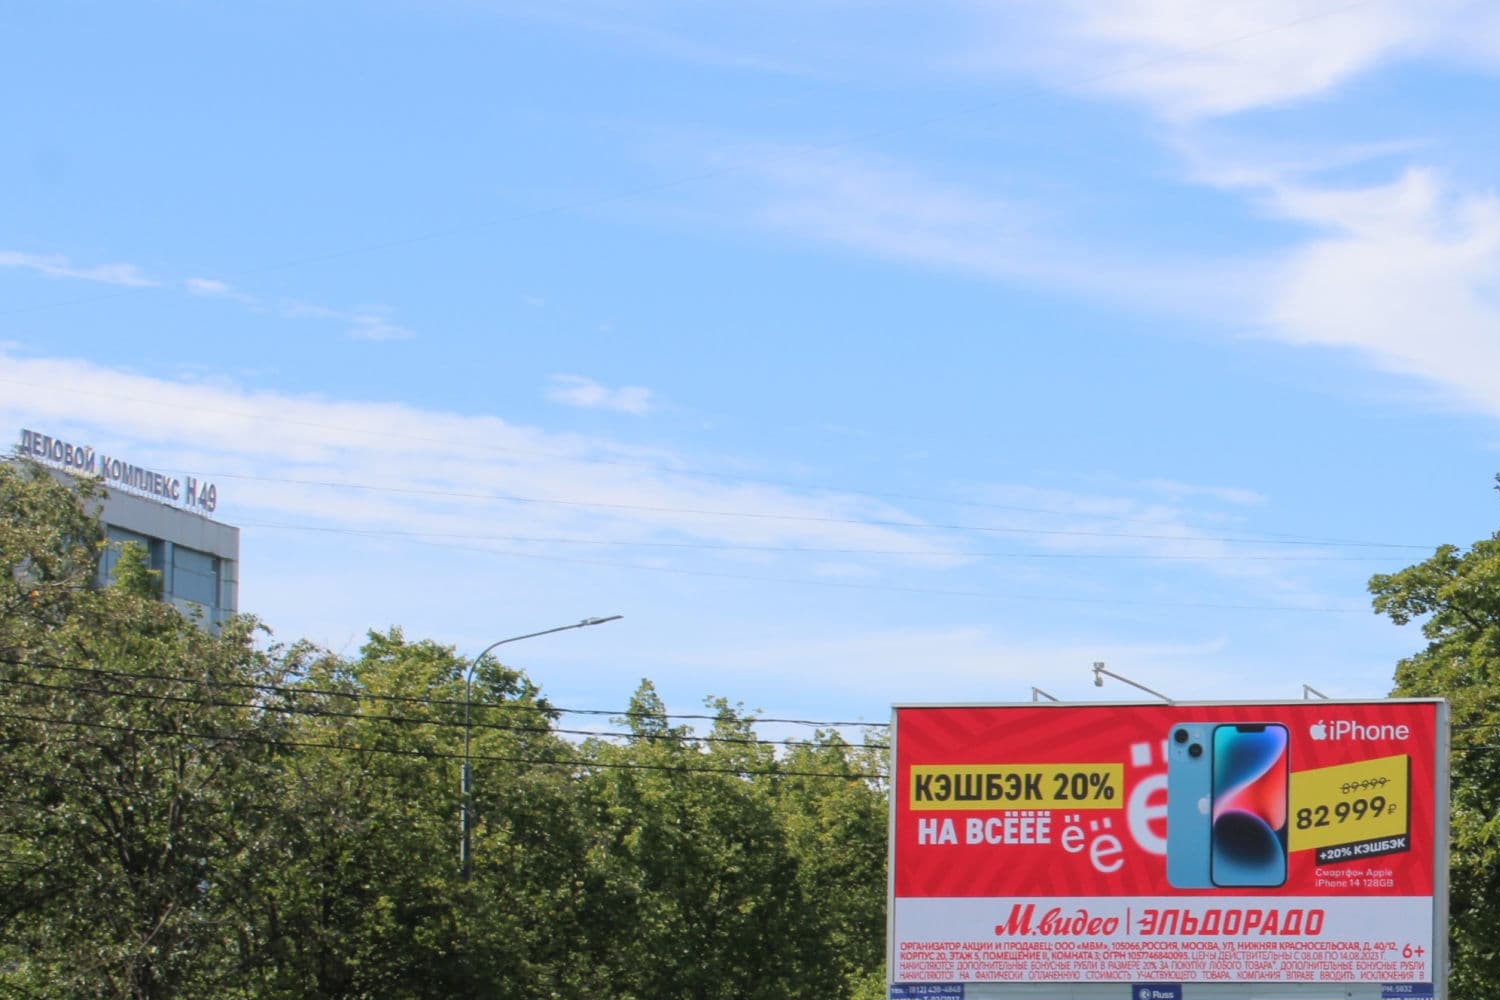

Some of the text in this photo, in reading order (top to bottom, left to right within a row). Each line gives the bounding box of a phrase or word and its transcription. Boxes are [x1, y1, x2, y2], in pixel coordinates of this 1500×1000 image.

[21, 428, 96, 474] ДЕЛОВОЙ
[101, 455, 180, 500] КОМПЛЕКС
[1330, 720, 1409, 741] iPhone
[914, 772, 1115, 801] КЭШБЭК 20%
[918, 818, 958, 845] НА
[1319, 838, 1406, 860] +20% КЭШБЭК
[1315, 868, 1393, 879] Смартфон Apple
[1315, 879, 1394, 888] iPhone 14 128GB
[995, 904, 1119, 936] М.видео
[1136, 909, 1325, 936] ЭЛЬДОРАДО
[900, 942, 961, 951] ОРГАНИЗАТОР
[962, 942, 993, 951] АКЦИИ
[994, 942, 1002, 951] И
[1054, 942, 1075, 951] ООО
[1238, 942, 1277, 951] НИЖНЯЯ
[1279, 942, 1362, 951] КРАСНОСЕЛЬСКАЯ,
[1402, 943, 1425, 959] 6+
[900, 952, 934, 961] КОРПУС
[950, 952, 972, 961] ЭТАЖ
[983, 952, 1041, 961] ПОМЕЩЕНИЕ
[1052, 952, 1093, 961] КОМНАТА
[1103, 952, 1126, 961] ОГРН
[1192, 952, 1217, 961] ЦЕНЫ
[1219, 952, 1292, 961] ДЕЙСТВИТЕЛЬНЫ
[1325, 952, 1339, 961] ПО
[957, 961, 1027, 970] ДОПОЛНИТЕЛЬНЫЕ
[1031, 961, 1071, 970] БОНУСНЫЕ
[1074, 961, 1098, 970] РУБЛИ
[1108, 961, 1140, 970] РАЗМЕРЕ
[1159, 961, 1169, 970] ЗА
[1171, 961, 1207, 970] ПОКУПКУ
[1209, 961, 1241, 970] ЛЮБОГО
[1280, 961, 1353, 970] ДОПОЛНИТЕЛЬНЫЕ
[1356, 961, 1397, 970] БОНУСНЫЕ
[1400, 961, 1425, 970] РУБЛИ
[960, 970, 970, 980] НА
[975, 970, 1023, 980] ФАКТИЧЕСКИ
[1029, 970, 1080, 980] ОПЛАЧЕННУЮ
[1086, 970, 1131, 980] СТОИМОСТЬ
[1137, 970, 1197, 980] УЧАСТВУЮЩЕГО
[1237, 970, 1281, 980] КОМПАНИЯ
[1286, 970, 1314, 980] ВПРАВЕ
[1320, 970, 1355, 980] ВВОДИТЬ
[1360, 970, 1414, 980] ИСКЛЮЧЕНИЯ
[1152, 990, 1175, 999] Russ
